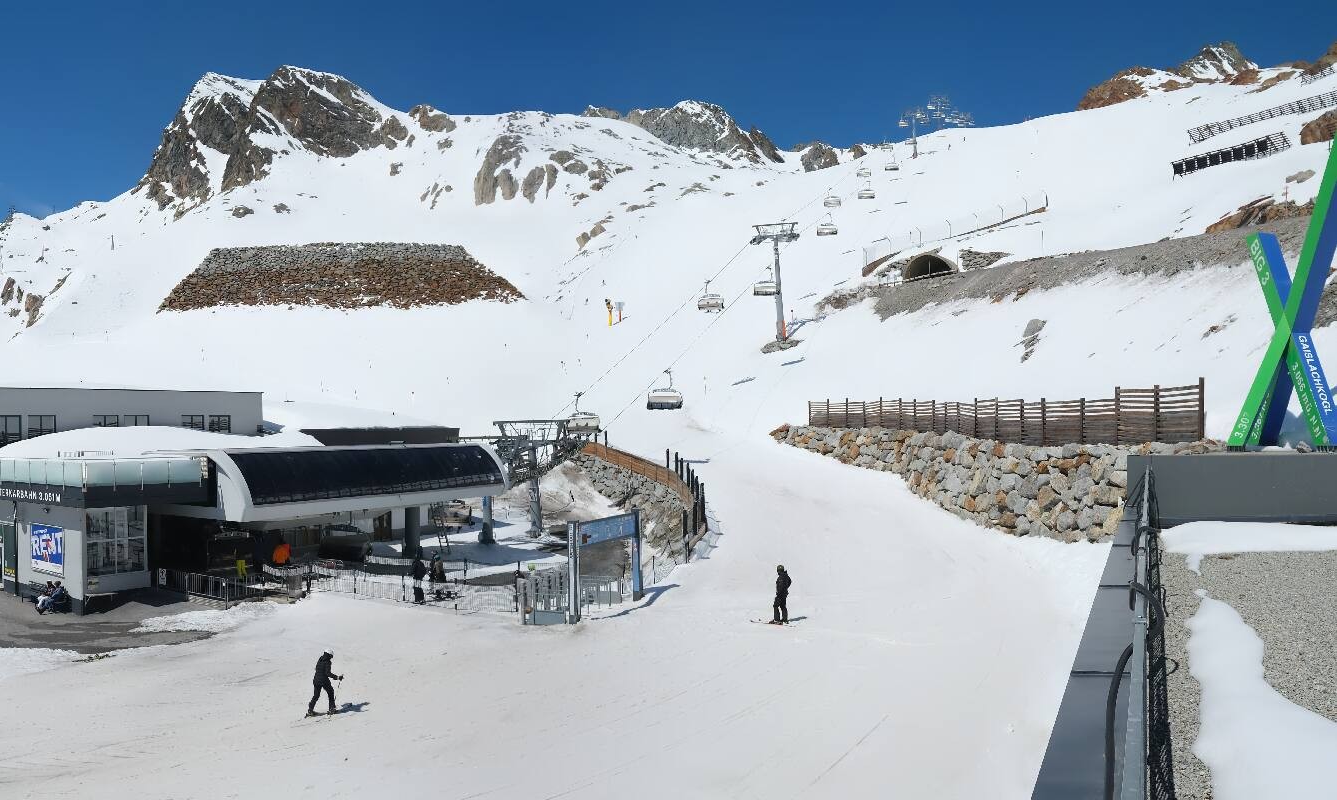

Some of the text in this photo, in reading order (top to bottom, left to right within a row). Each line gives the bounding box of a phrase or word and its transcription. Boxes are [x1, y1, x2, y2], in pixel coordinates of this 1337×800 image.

[1250, 239, 1269, 286] BIG 3
[1298, 335, 1332, 415] GAISLACHKOGL
